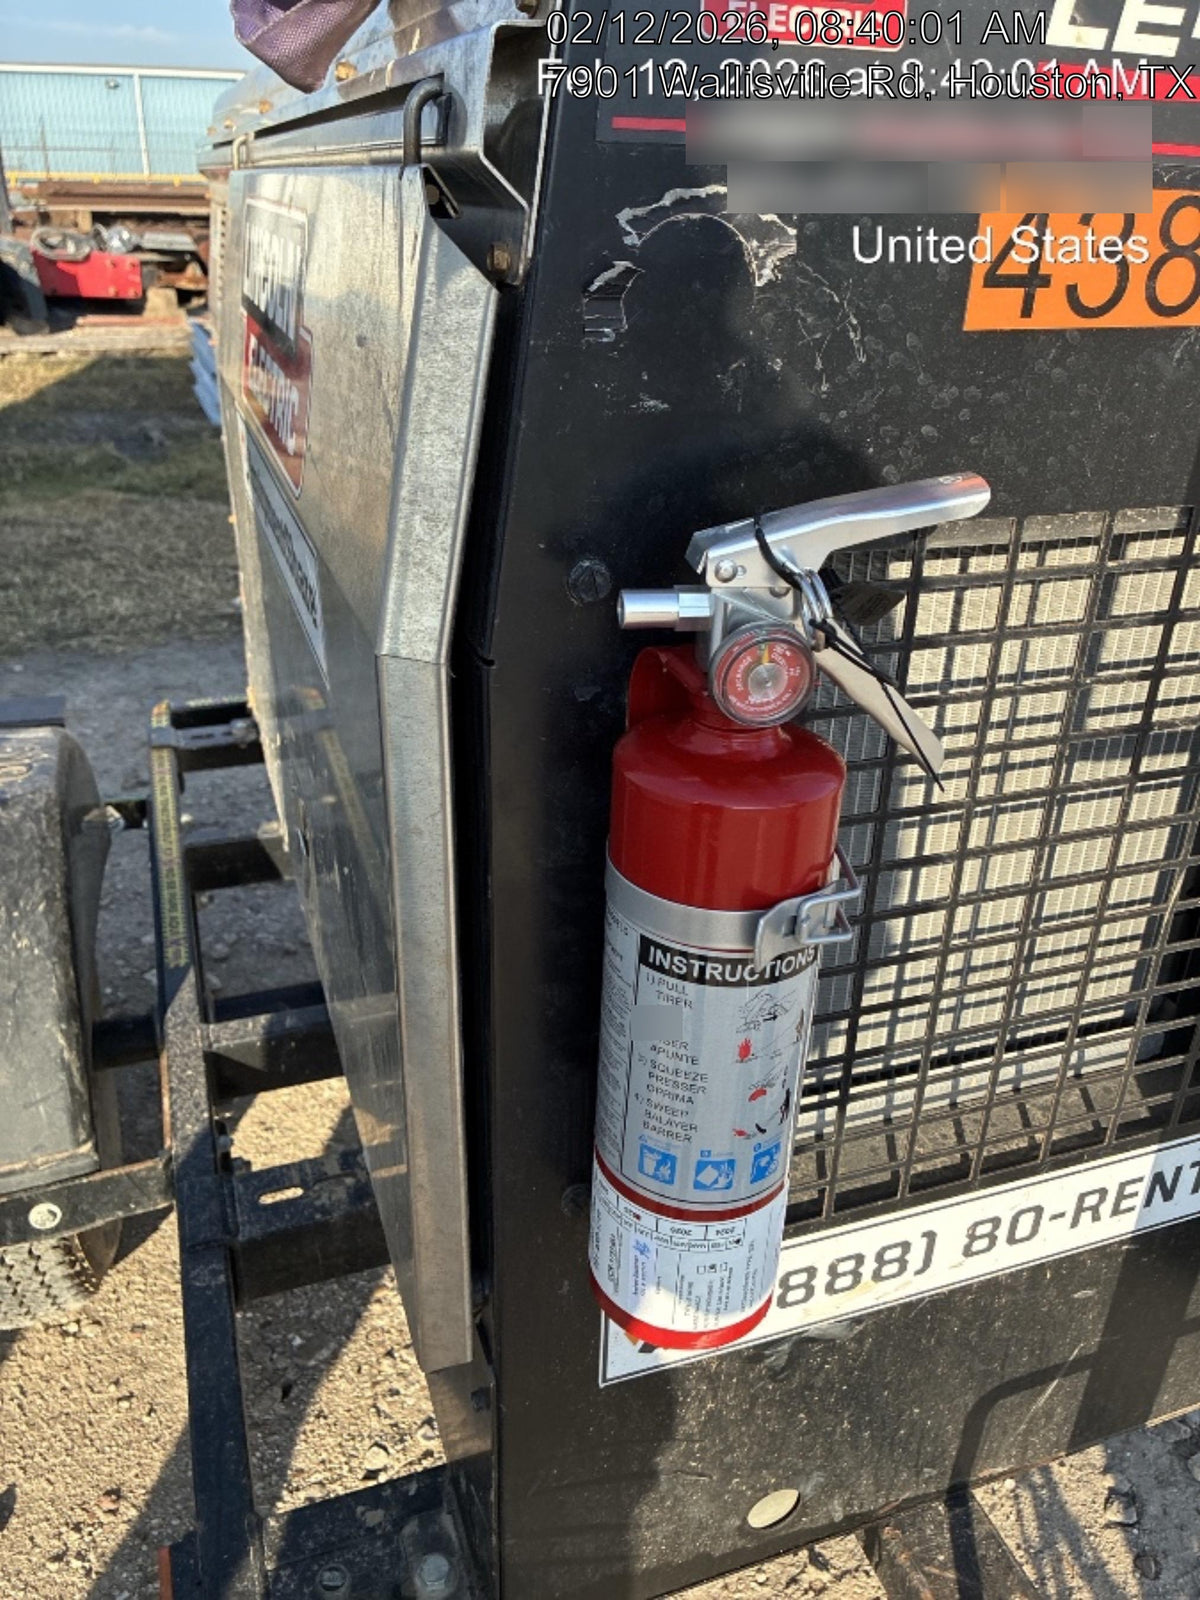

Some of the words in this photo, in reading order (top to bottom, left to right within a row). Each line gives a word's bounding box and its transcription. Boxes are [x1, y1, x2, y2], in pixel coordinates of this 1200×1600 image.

[1046, 0, 1200, 58] LE
[649, 944, 815, 983] INSTRUCTIONS
[658, 977, 688, 996] PULL
[648, 1071, 707, 1095] PRESSER
[650, 1059, 708, 1083] SQUEEZE
[646, 1098, 689, 1118] SWEEP
